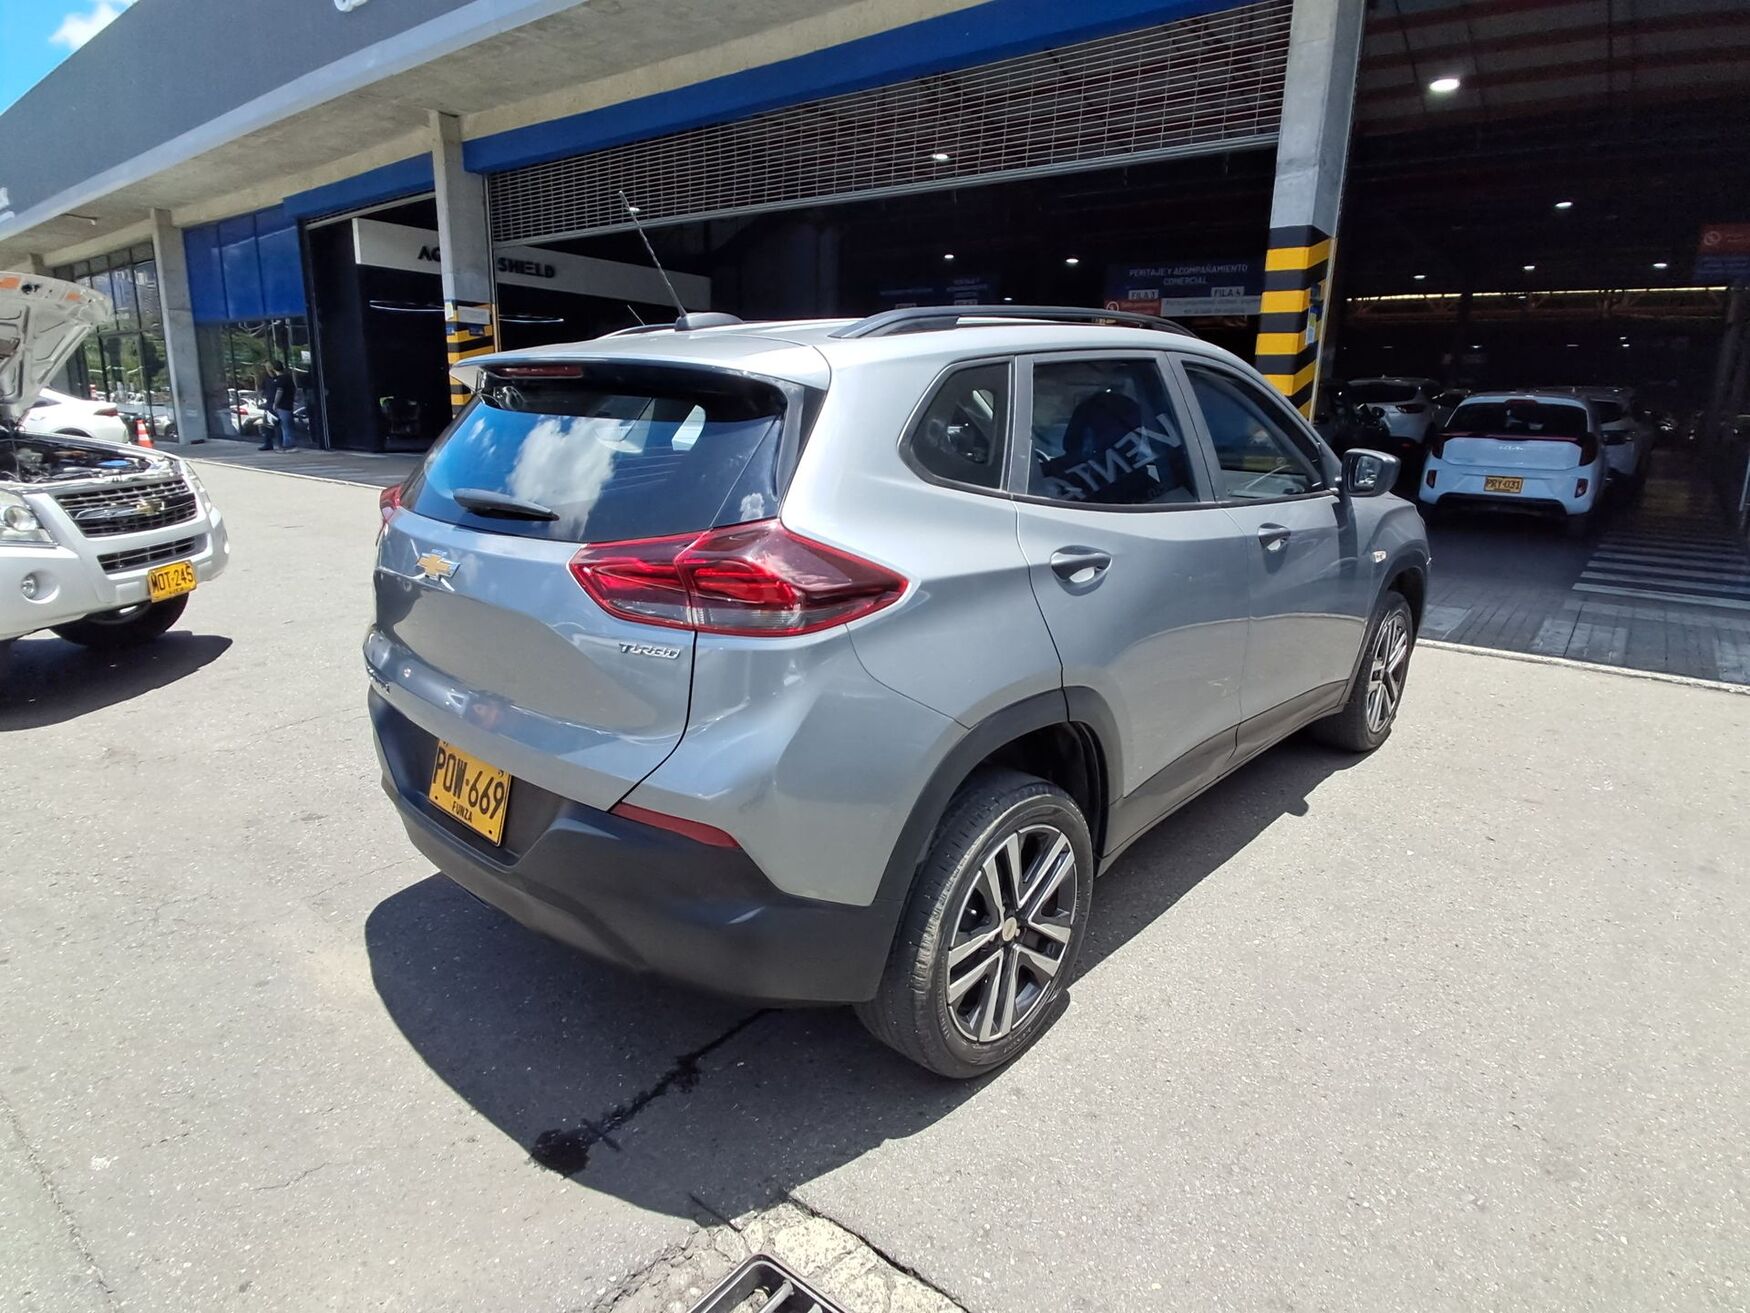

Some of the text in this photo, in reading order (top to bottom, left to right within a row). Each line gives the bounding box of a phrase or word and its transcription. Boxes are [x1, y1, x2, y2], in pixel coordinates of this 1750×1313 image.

[497, 257, 556, 278] SHIELD
[619, 641, 680, 660] TURBO
[451, 801, 473, 823] FUNZA
